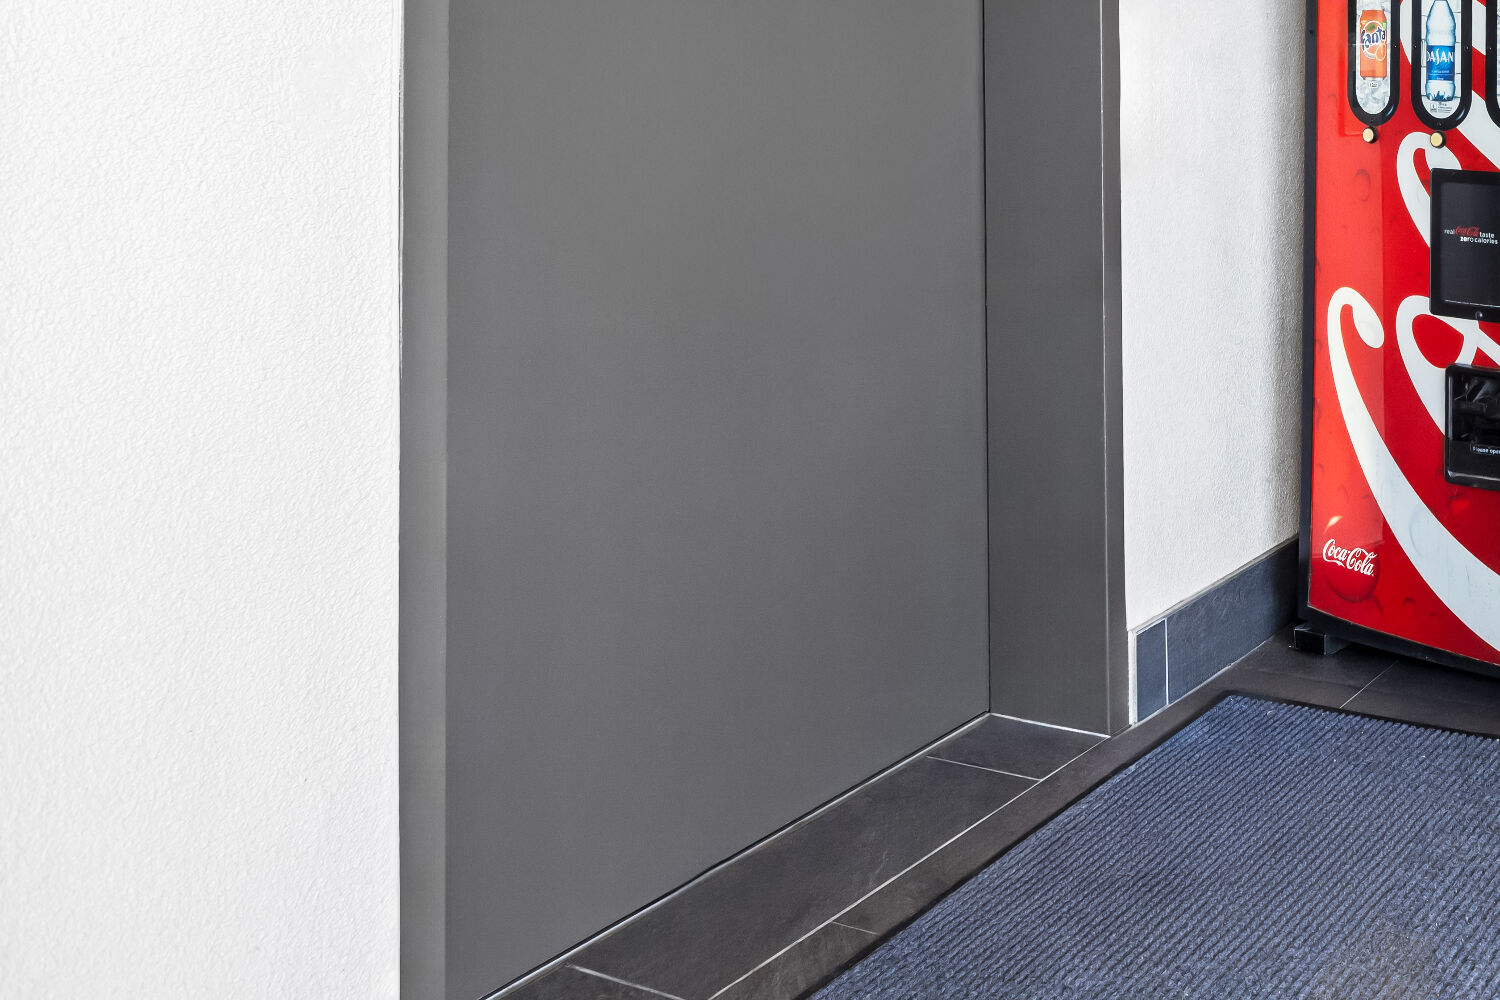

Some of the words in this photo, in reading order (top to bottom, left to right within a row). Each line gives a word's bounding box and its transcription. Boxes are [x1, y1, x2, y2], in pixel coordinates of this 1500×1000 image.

[1361, 26, 1386, 51] Fanta
[1474, 237, 1499, 245] calories
[1479, 231, 1495, 239] taste
[1322, 538, 1378, 577] Coca-Cola
